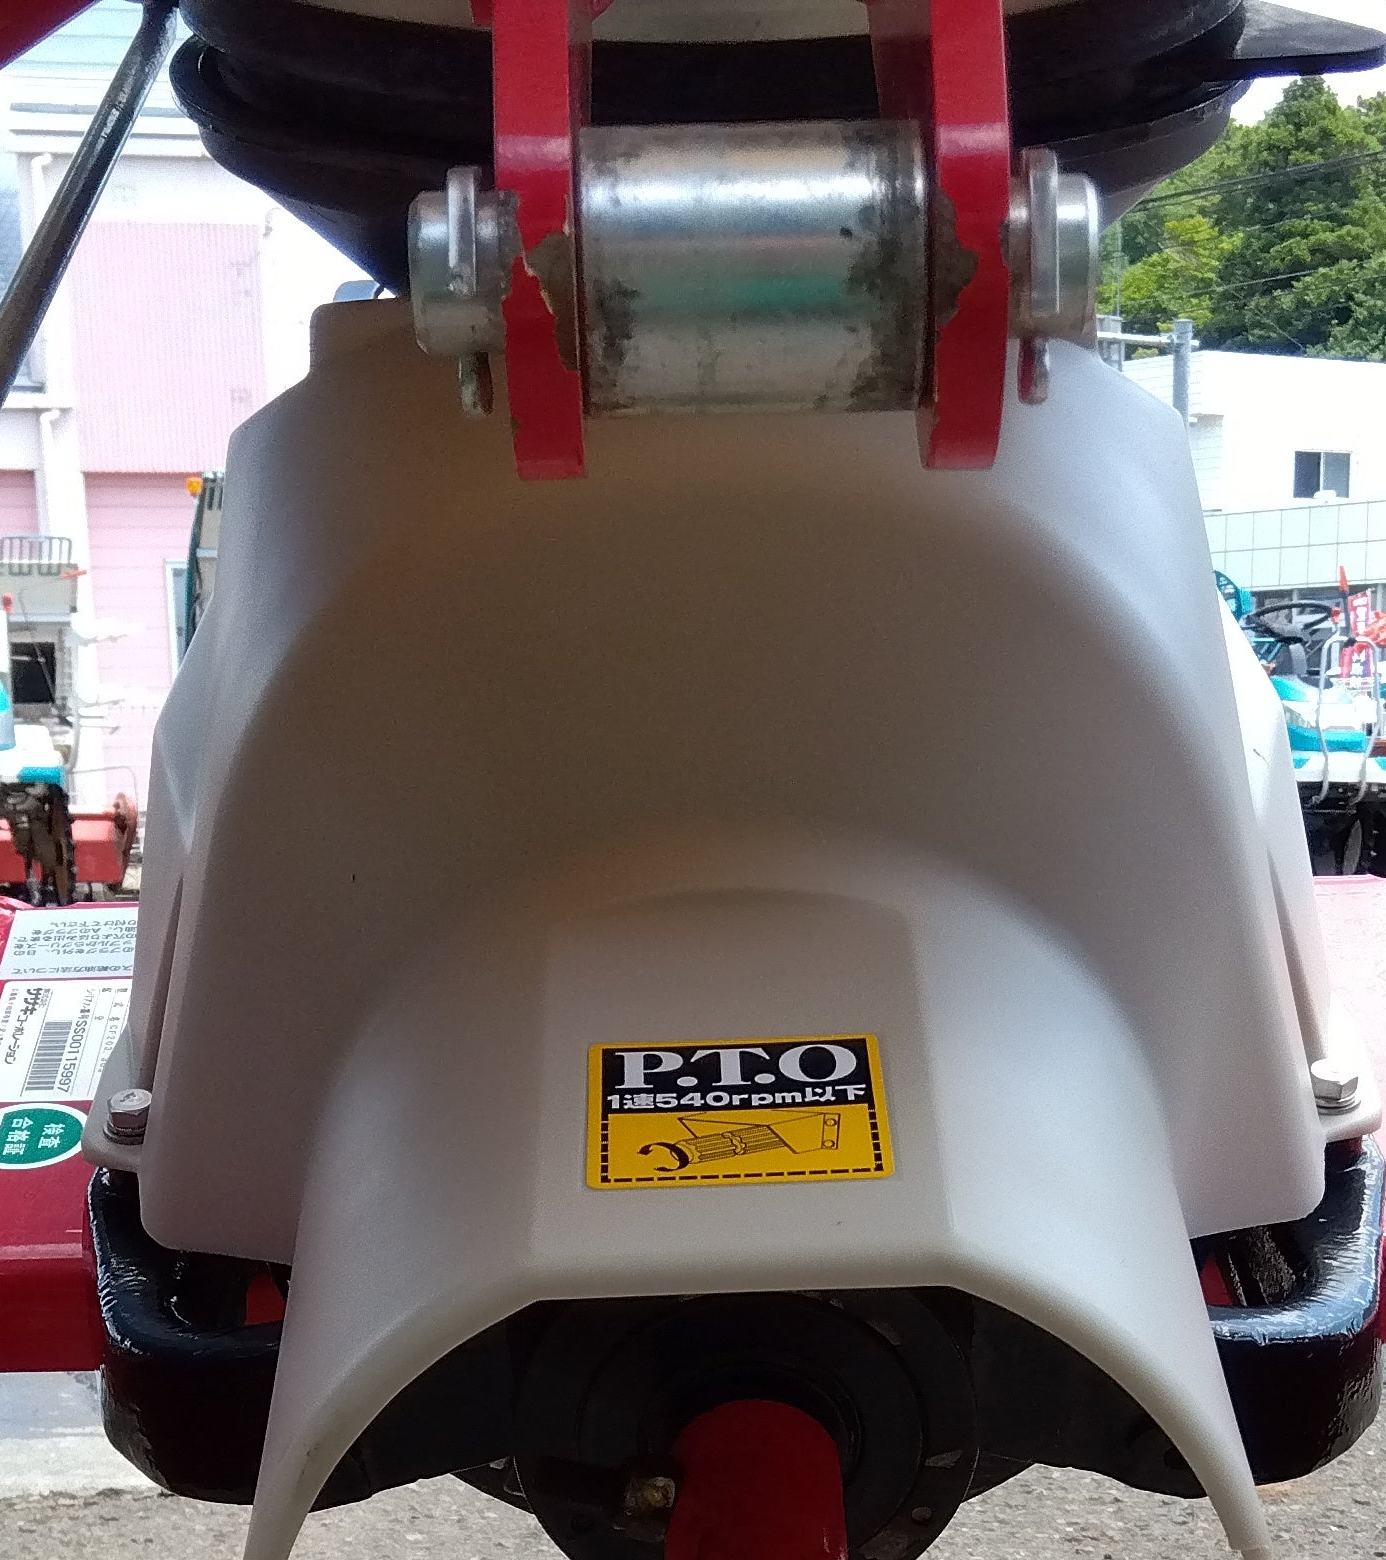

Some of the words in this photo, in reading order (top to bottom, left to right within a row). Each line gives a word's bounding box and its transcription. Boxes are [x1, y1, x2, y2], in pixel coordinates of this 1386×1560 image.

[57, 1020, 88, 1093] SS00115997
[614, 1044, 858, 1090] P.T.O
[607, 1083, 867, 1110] 1速540rpm以下
[2, 1116, 34, 1156] 合格証
[38, 1123, 66, 1149] 検査
